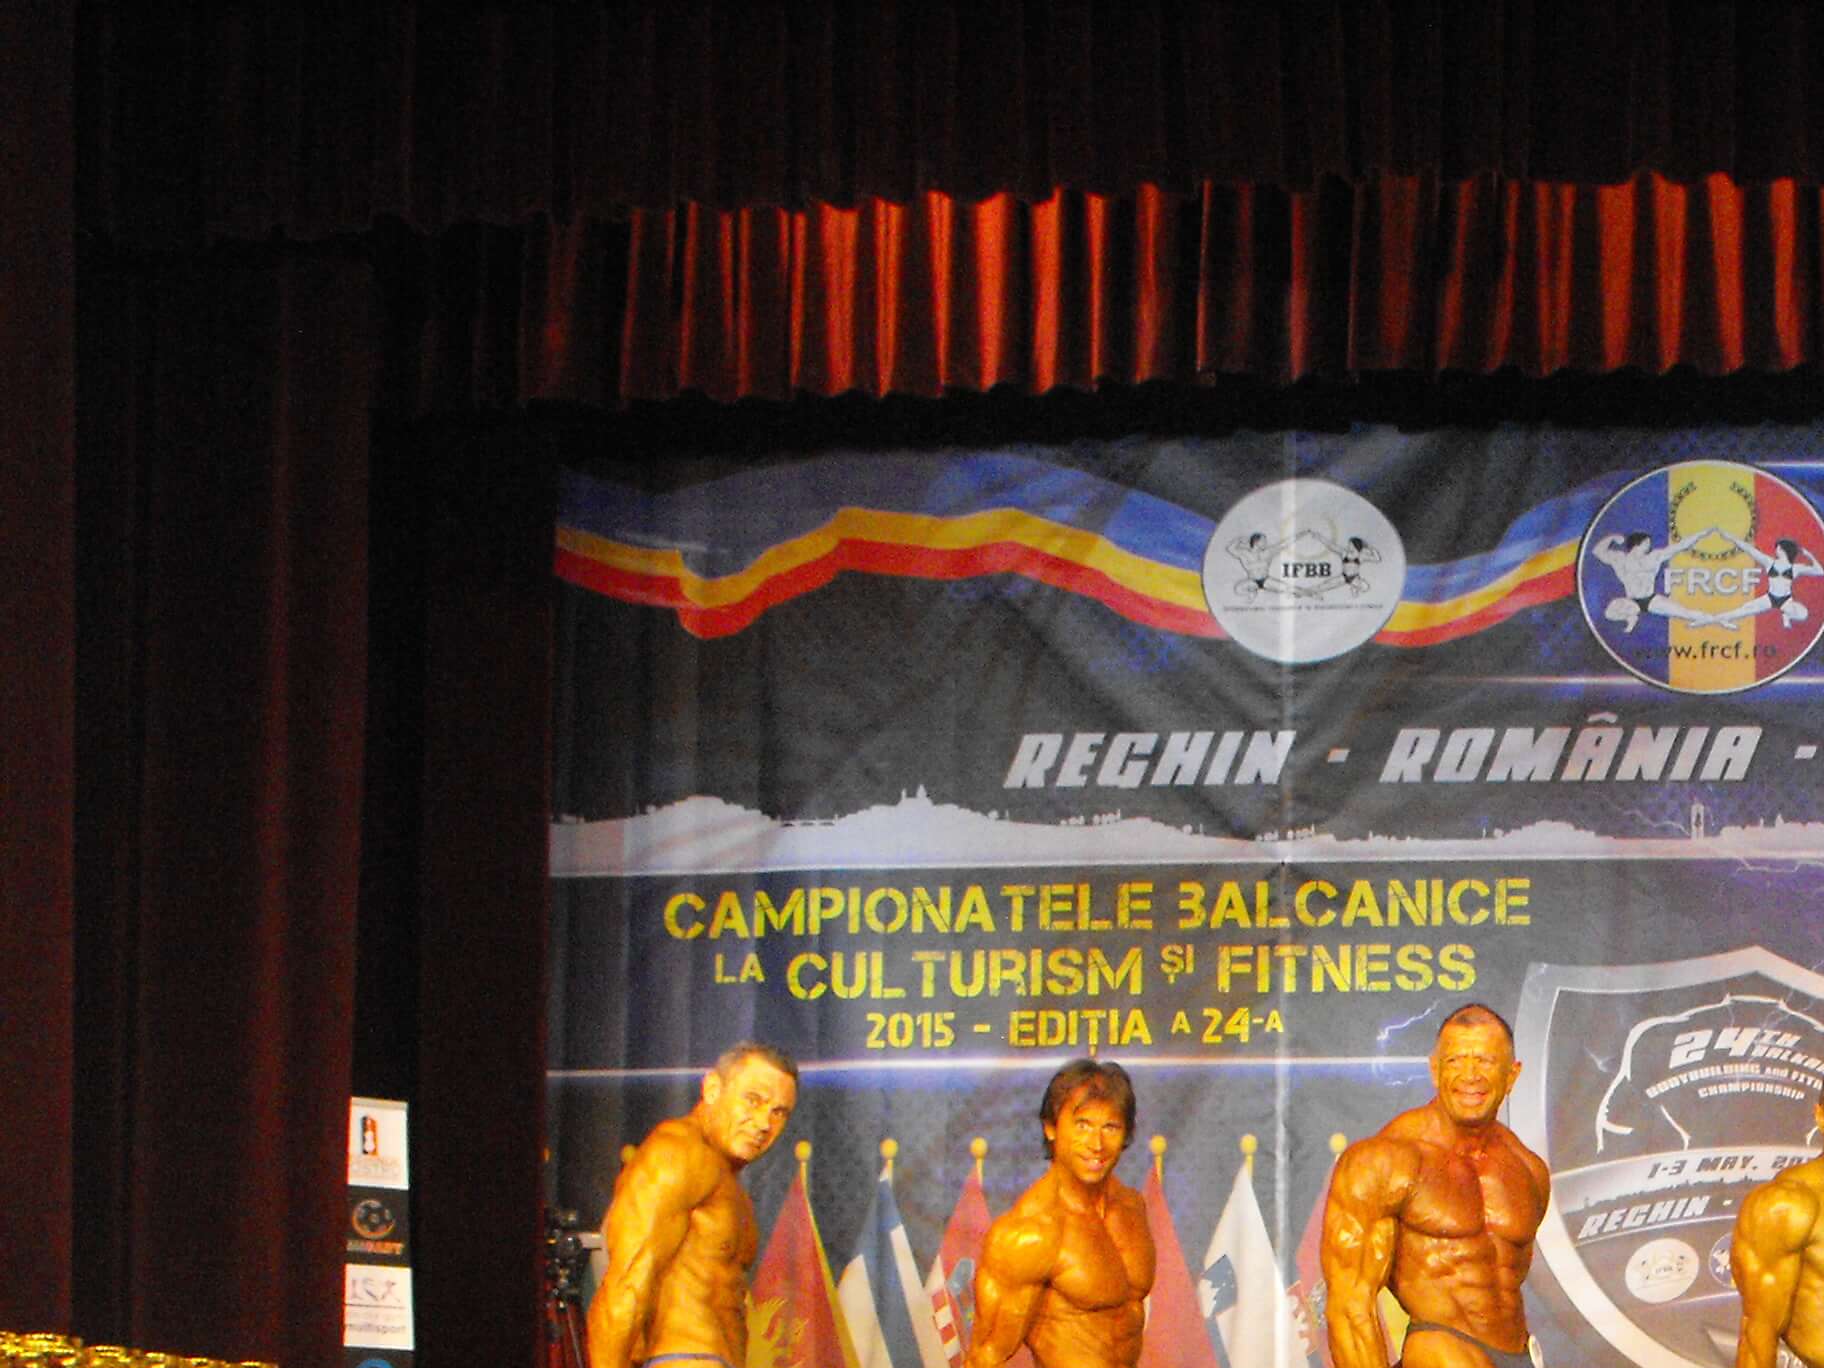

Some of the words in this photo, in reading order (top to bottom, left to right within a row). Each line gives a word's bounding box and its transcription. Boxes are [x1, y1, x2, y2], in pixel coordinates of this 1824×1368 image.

[1282, 562, 1332, 579] IFBB
[1664, 567, 1762, 596] FRCF
[1003, 729, 1297, 789] REGHIN
[1378, 711, 1763, 784] ROMÂNIA
[663, 881, 1154, 941] CAMPIONATELE
[1178, 877, 1532, 931] BALCANICE
[713, 952, 766, 985] LA
[786, 943, 1144, 1001] CULTURISM
[1216, 942, 1478, 994] FITNESS
[864, 1011, 956, 1050] 2015
[1171, 1010, 1192, 1035] A
[1577, 1196, 1711, 1241] REGHIN
